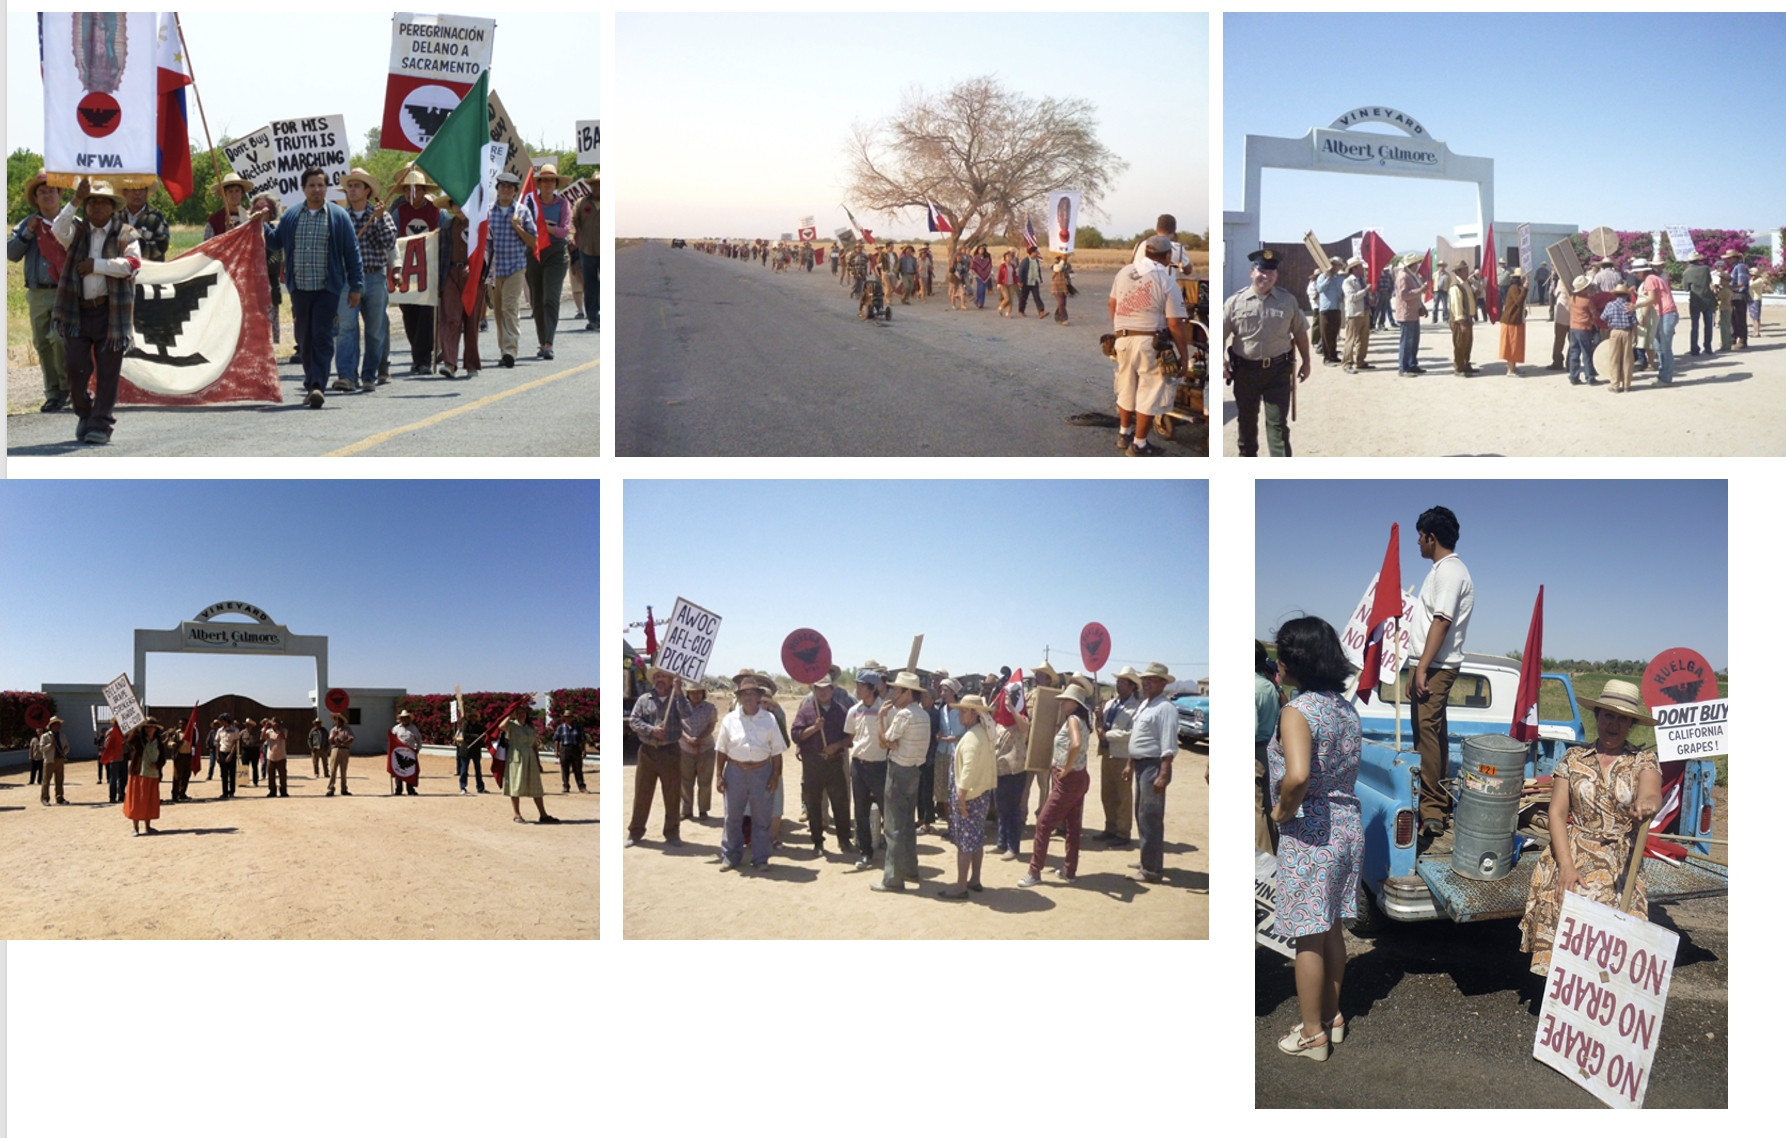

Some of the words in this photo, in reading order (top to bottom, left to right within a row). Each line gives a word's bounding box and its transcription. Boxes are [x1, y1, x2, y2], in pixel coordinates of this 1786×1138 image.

[399, 23, 485, 42] PEREGRINACIÓN
[412, 40, 459, 56] DELANO
[461, 44, 470, 57] A
[401, 56, 480, 75] SACRAMENTO
[272, 120, 298, 137] FOR
[301, 117, 329, 132] HIS
[1340, 108, 1423, 134] VINEYARD
[248, 132, 270, 149] Buy
[274, 135, 318, 153] TRUTH
[319, 132, 336, 147] IS
[1322, 139, 1375, 161] Albert
[1378, 144, 1438, 166] Gilmore
[76, 152, 124, 169] NFWA
[277, 149, 345, 174] MARCHING
[279, 175, 299, 195] ON
[201, 602, 267, 621] VINEYARD
[676, 604, 717, 636] AWOC
[188, 628, 229, 646] Albert
[231, 630, 280, 648] Gilmore
[668, 626, 712, 657] AFL-CIO
[1342, 627, 1365, 650] NO
[659, 646, 705, 680] PICKET
[1653, 659, 1704, 684] HUELGA
[1657, 705, 1698, 726] DONT
[1699, 702, 1728, 722] BUY
[1668, 725, 1723, 741] CALIFORNIA
[1558, 916, 1628, 975] GRAPE
[1630, 949, 1668, 996] NO
[1549, 965, 1617, 1027] GRAPE
[1618, 1003, 1656, 1050] NO
[1540, 1013, 1605, 1076] GRAPE
[1607, 1054, 1644, 1102] NO
